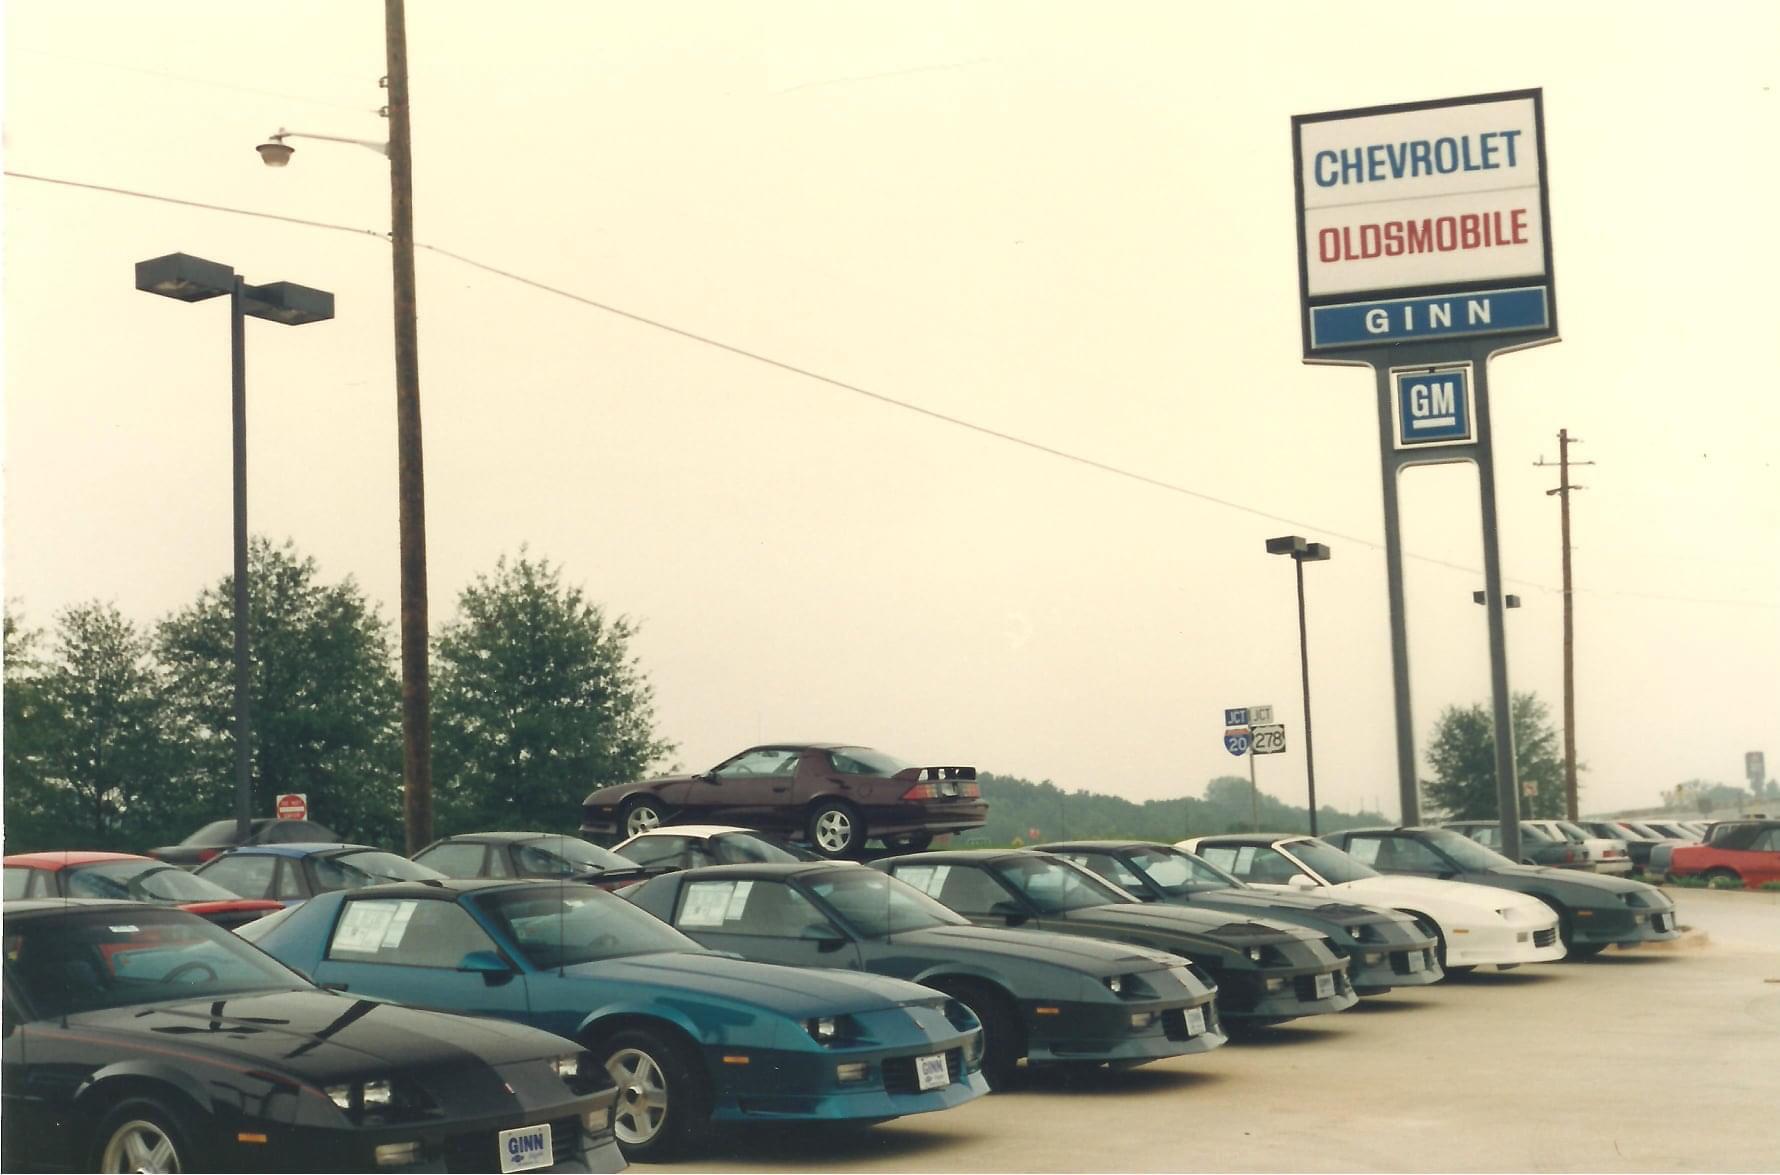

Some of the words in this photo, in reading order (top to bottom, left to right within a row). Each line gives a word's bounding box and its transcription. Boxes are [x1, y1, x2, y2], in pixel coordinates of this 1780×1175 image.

[1314, 130, 1521, 187] CHEVROLET
[1318, 208, 1528, 263] OLDSMOBILE
[1365, 299, 1491, 334] GINN
[1411, 382, 1455, 417] GM
[1228, 710, 1246, 724] JCT
[1254, 708, 1270, 721] JCT
[1229, 737, 1247, 751] 20
[1255, 731, 1283, 748] 278
[508, 1133, 544, 1154] GINN
